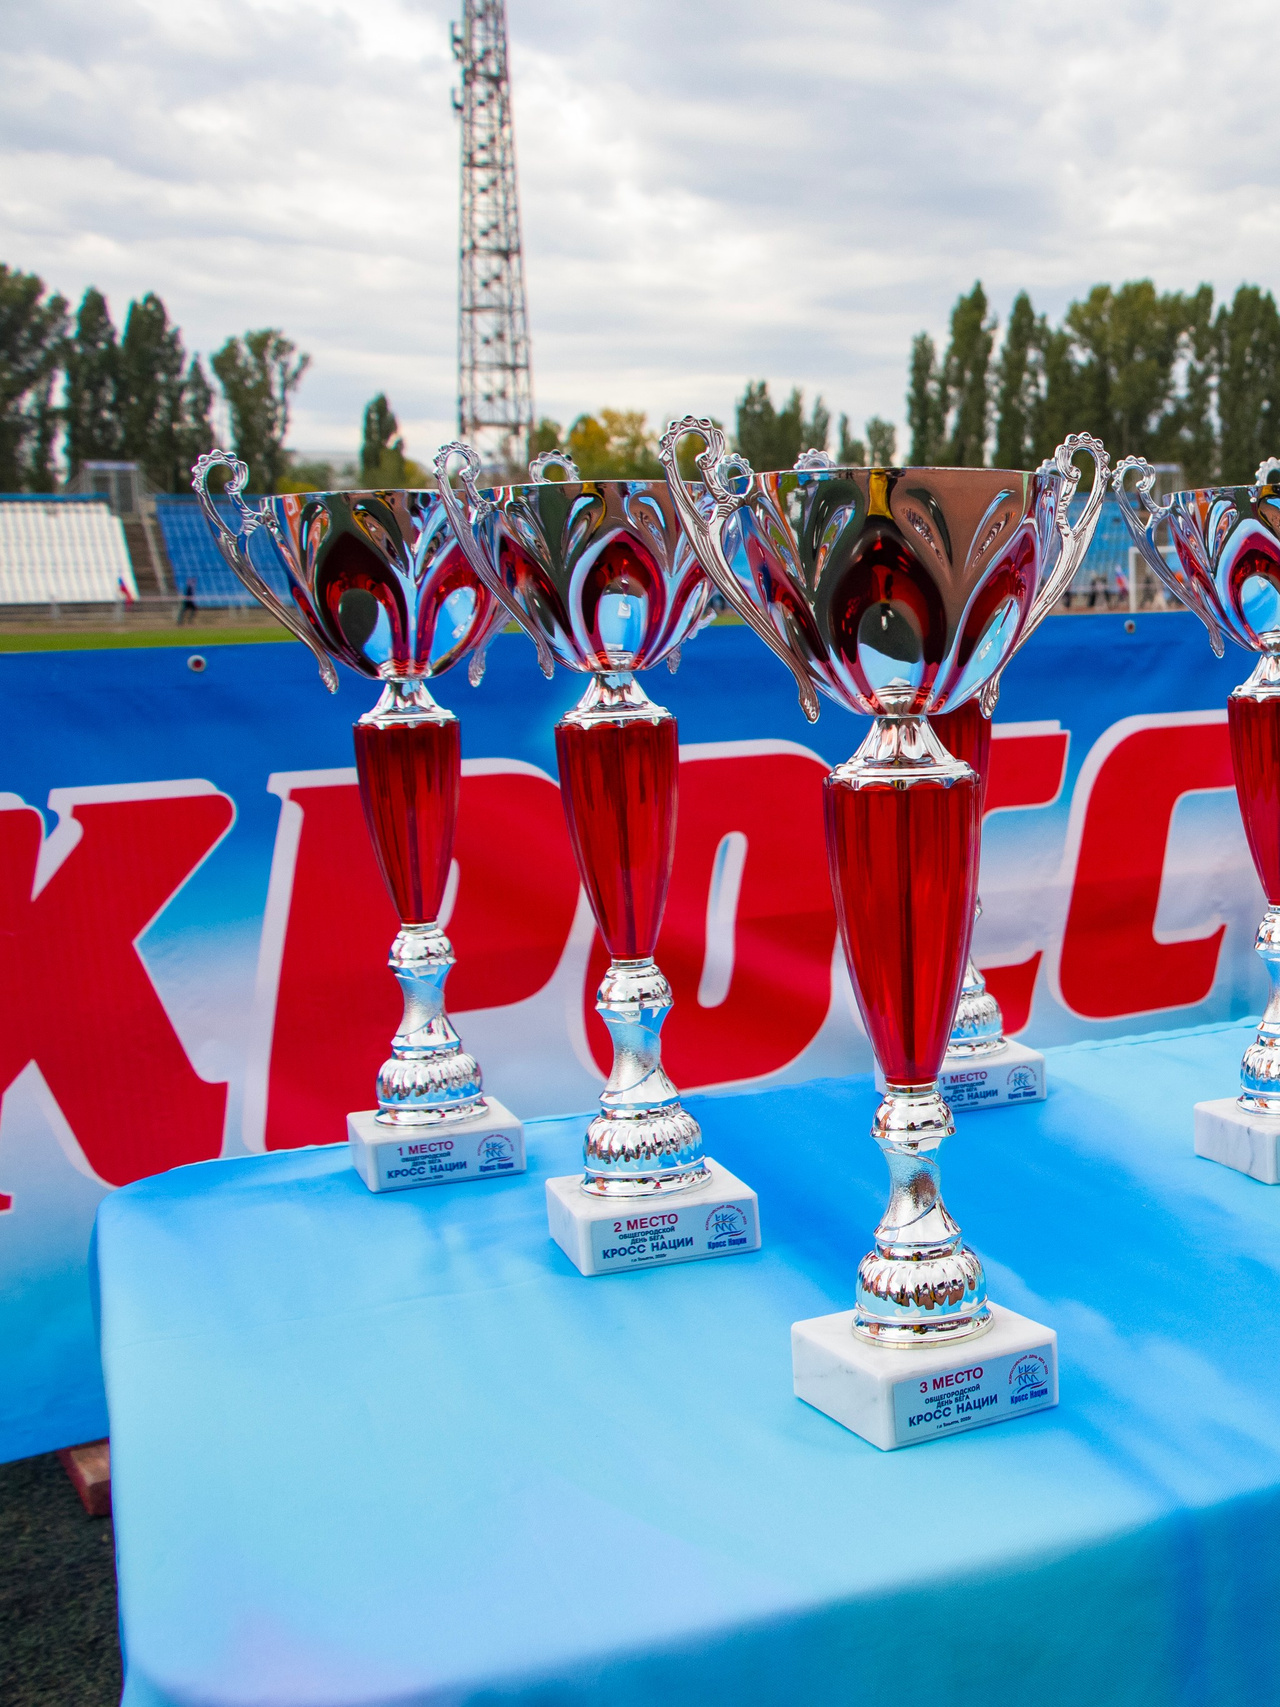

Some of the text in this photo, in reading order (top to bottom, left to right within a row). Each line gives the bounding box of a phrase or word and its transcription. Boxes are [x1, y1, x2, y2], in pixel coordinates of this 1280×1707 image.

[950, 1071, 988, 1084] МЕСТО
[967, 1089, 998, 1100] НАЦИИ
[408, 1140, 454, 1155] МЕСТО
[387, 1167, 426, 1180] КРОСС
[430, 1161, 467, 1174] НАЦИИ
[613, 1213, 679, 1233] 2 МЕСТО
[618, 1226, 675, 1240] ОБЩЕГОРОДСКОЙ
[630, 1236, 648, 1245] ДЕНЬ
[602, 1237, 694, 1259] КРОСС НАЦИИ
[919, 1367, 984, 1393] 3 МЕСТО
[924, 1384, 981, 1404] ОБЩЕГОРОДСКОЙ
[936, 1394, 970, 1408] ДЕНЬ БЕГА
[1010, 1388, 1048, 1405] Кросс Нации
[908, 1394, 998, 1427] КРОСС НАЦИИ
